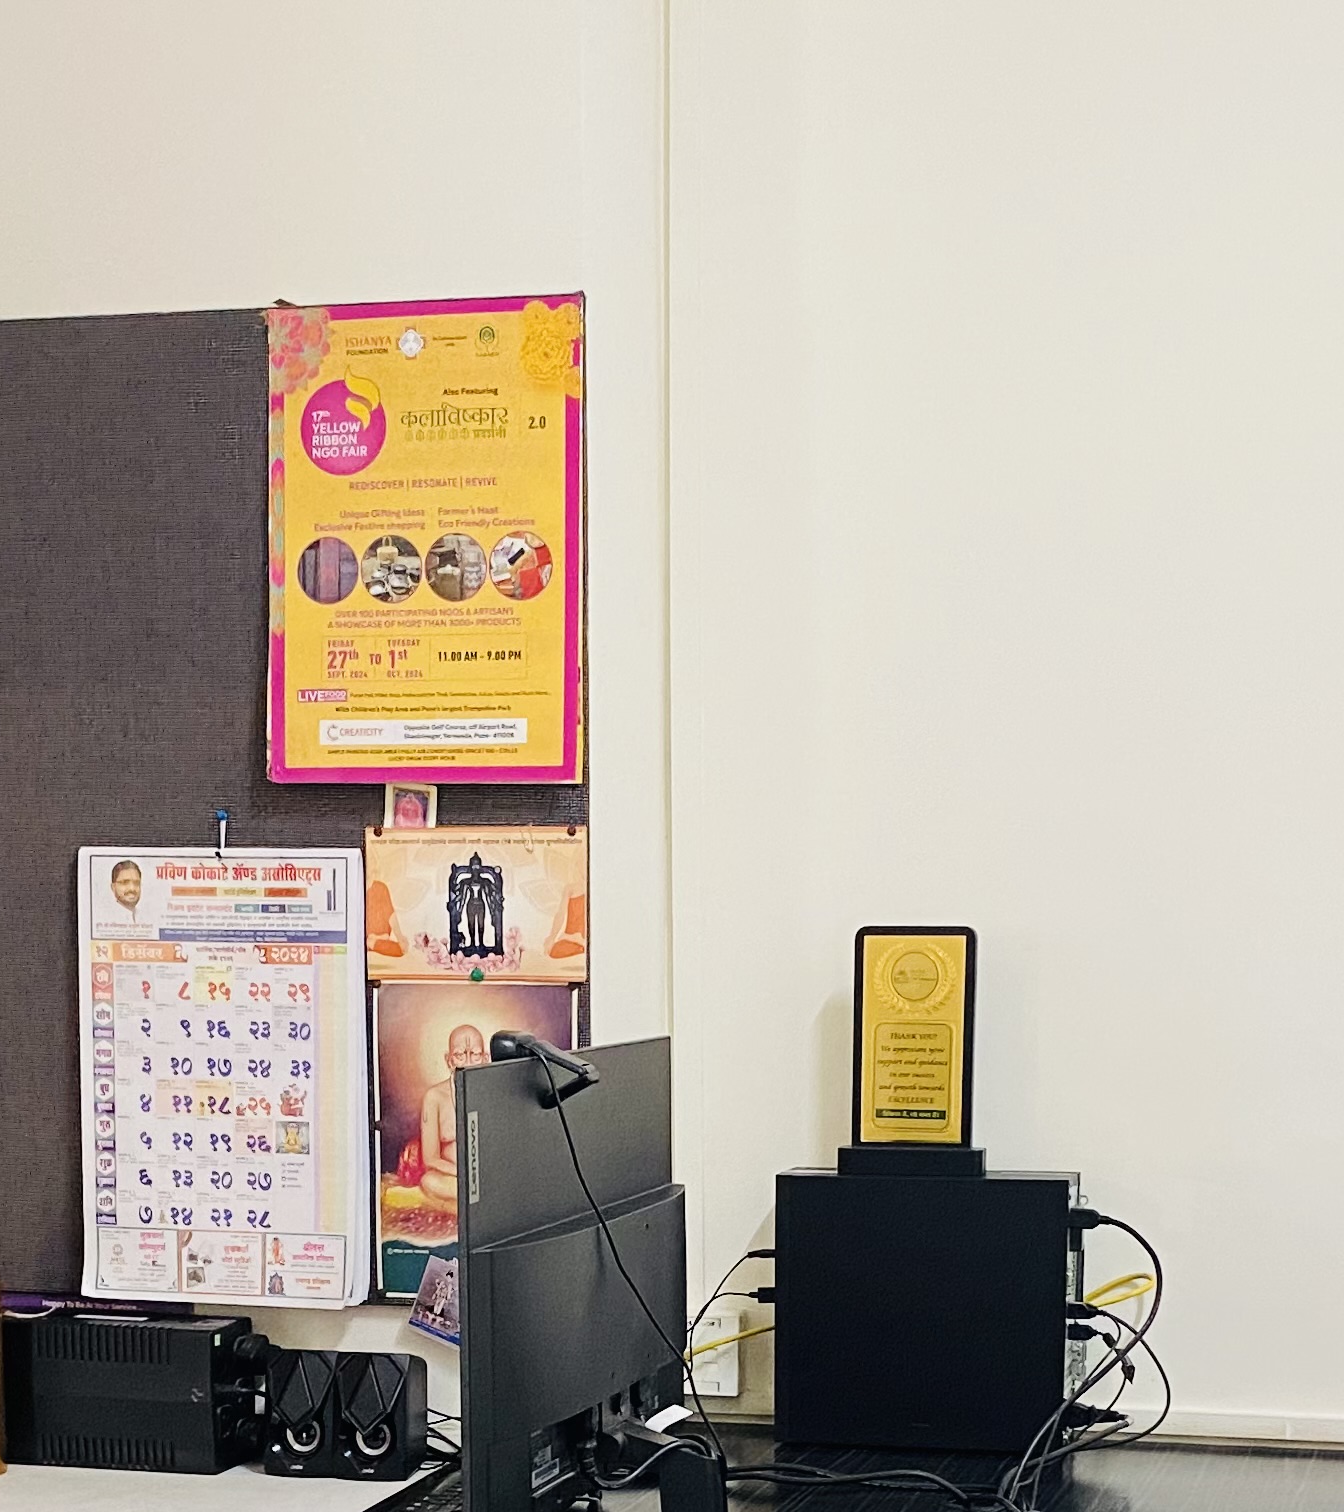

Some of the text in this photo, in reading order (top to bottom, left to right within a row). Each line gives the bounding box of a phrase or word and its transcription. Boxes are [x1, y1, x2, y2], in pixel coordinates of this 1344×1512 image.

[345, 335, 392, 347] ISHANYA
[346, 347, 388, 356] FOUNDATION
[461, 387, 498, 396] Featuring
[311, 410, 330, 422] 17th
[312, 421, 360, 434] YELLOW
[528, 416, 546, 429] 2.0
[312, 434, 357, 446] RIBBON
[312, 445, 367, 459] NGO FAIR
[349, 477, 497, 490] REDISCOVER RESONATE REVIVE
[314, 522, 353, 532] Exclusive
[438, 517, 535, 529] Eco Friendly Creations
[375, 609, 438, 618] PARTICIPATING
[334, 620, 382, 628] SHOWCASE
[384, 620, 396, 628] OF
[397, 620, 422, 628] MORE
[423, 619, 447, 627] THAN
[476, 617, 522, 627] PRODUCTS
[327, 639, 421, 648] FRIDAY TUESDAY
[327, 649, 408, 670] 27th TO 1st
[438, 651, 462, 662] 11.00
[464, 651, 477, 662] AM
[487, 650, 506, 661] 9.00
[508, 649, 522, 661] PM
[327, 671, 347, 679] SEPT.
[298, 690, 325, 702] LIVE
[339, 727, 384, 737] CREATICITY
[270, 945, 309, 963] २०२४
[141, 980, 311, 1002] १ ८ १५ २२ २९
[141, 1018, 151, 1037] २
[180, 1019, 191, 1038] ९
[206, 1019, 231, 1039] १६
[248, 1021, 271, 1040] २३
[288, 1021, 311, 1040] ३०
[890, 1032, 917, 1040] THANK
[141, 1056, 312, 1079] ३ १० १७ २४ ३१
[140, 1093, 152, 1112] ४
[172, 1095, 193, 1113] ११
[207, 1095, 232, 1115] १८
[247, 1097, 272, 1116] २५
[887, 1095, 935, 1104] EXCELLENCE
[140, 1131, 152, 1150] ५
[172, 1132, 193, 1151] १२
[209, 1133, 232, 1152] १९
[246, 1134, 272, 1154] २६
[139, 1168, 153, 1187] ६
[172, 1169, 194, 1188] १३
[210, 1170, 233, 1190] २०
[247, 1171, 272, 1191] २७
[138, 1205, 153, 1224] ७
[170, 1206, 193, 1226] १४
[210, 1208, 232, 1227] २१
[246, 1209, 272, 1228] २८
